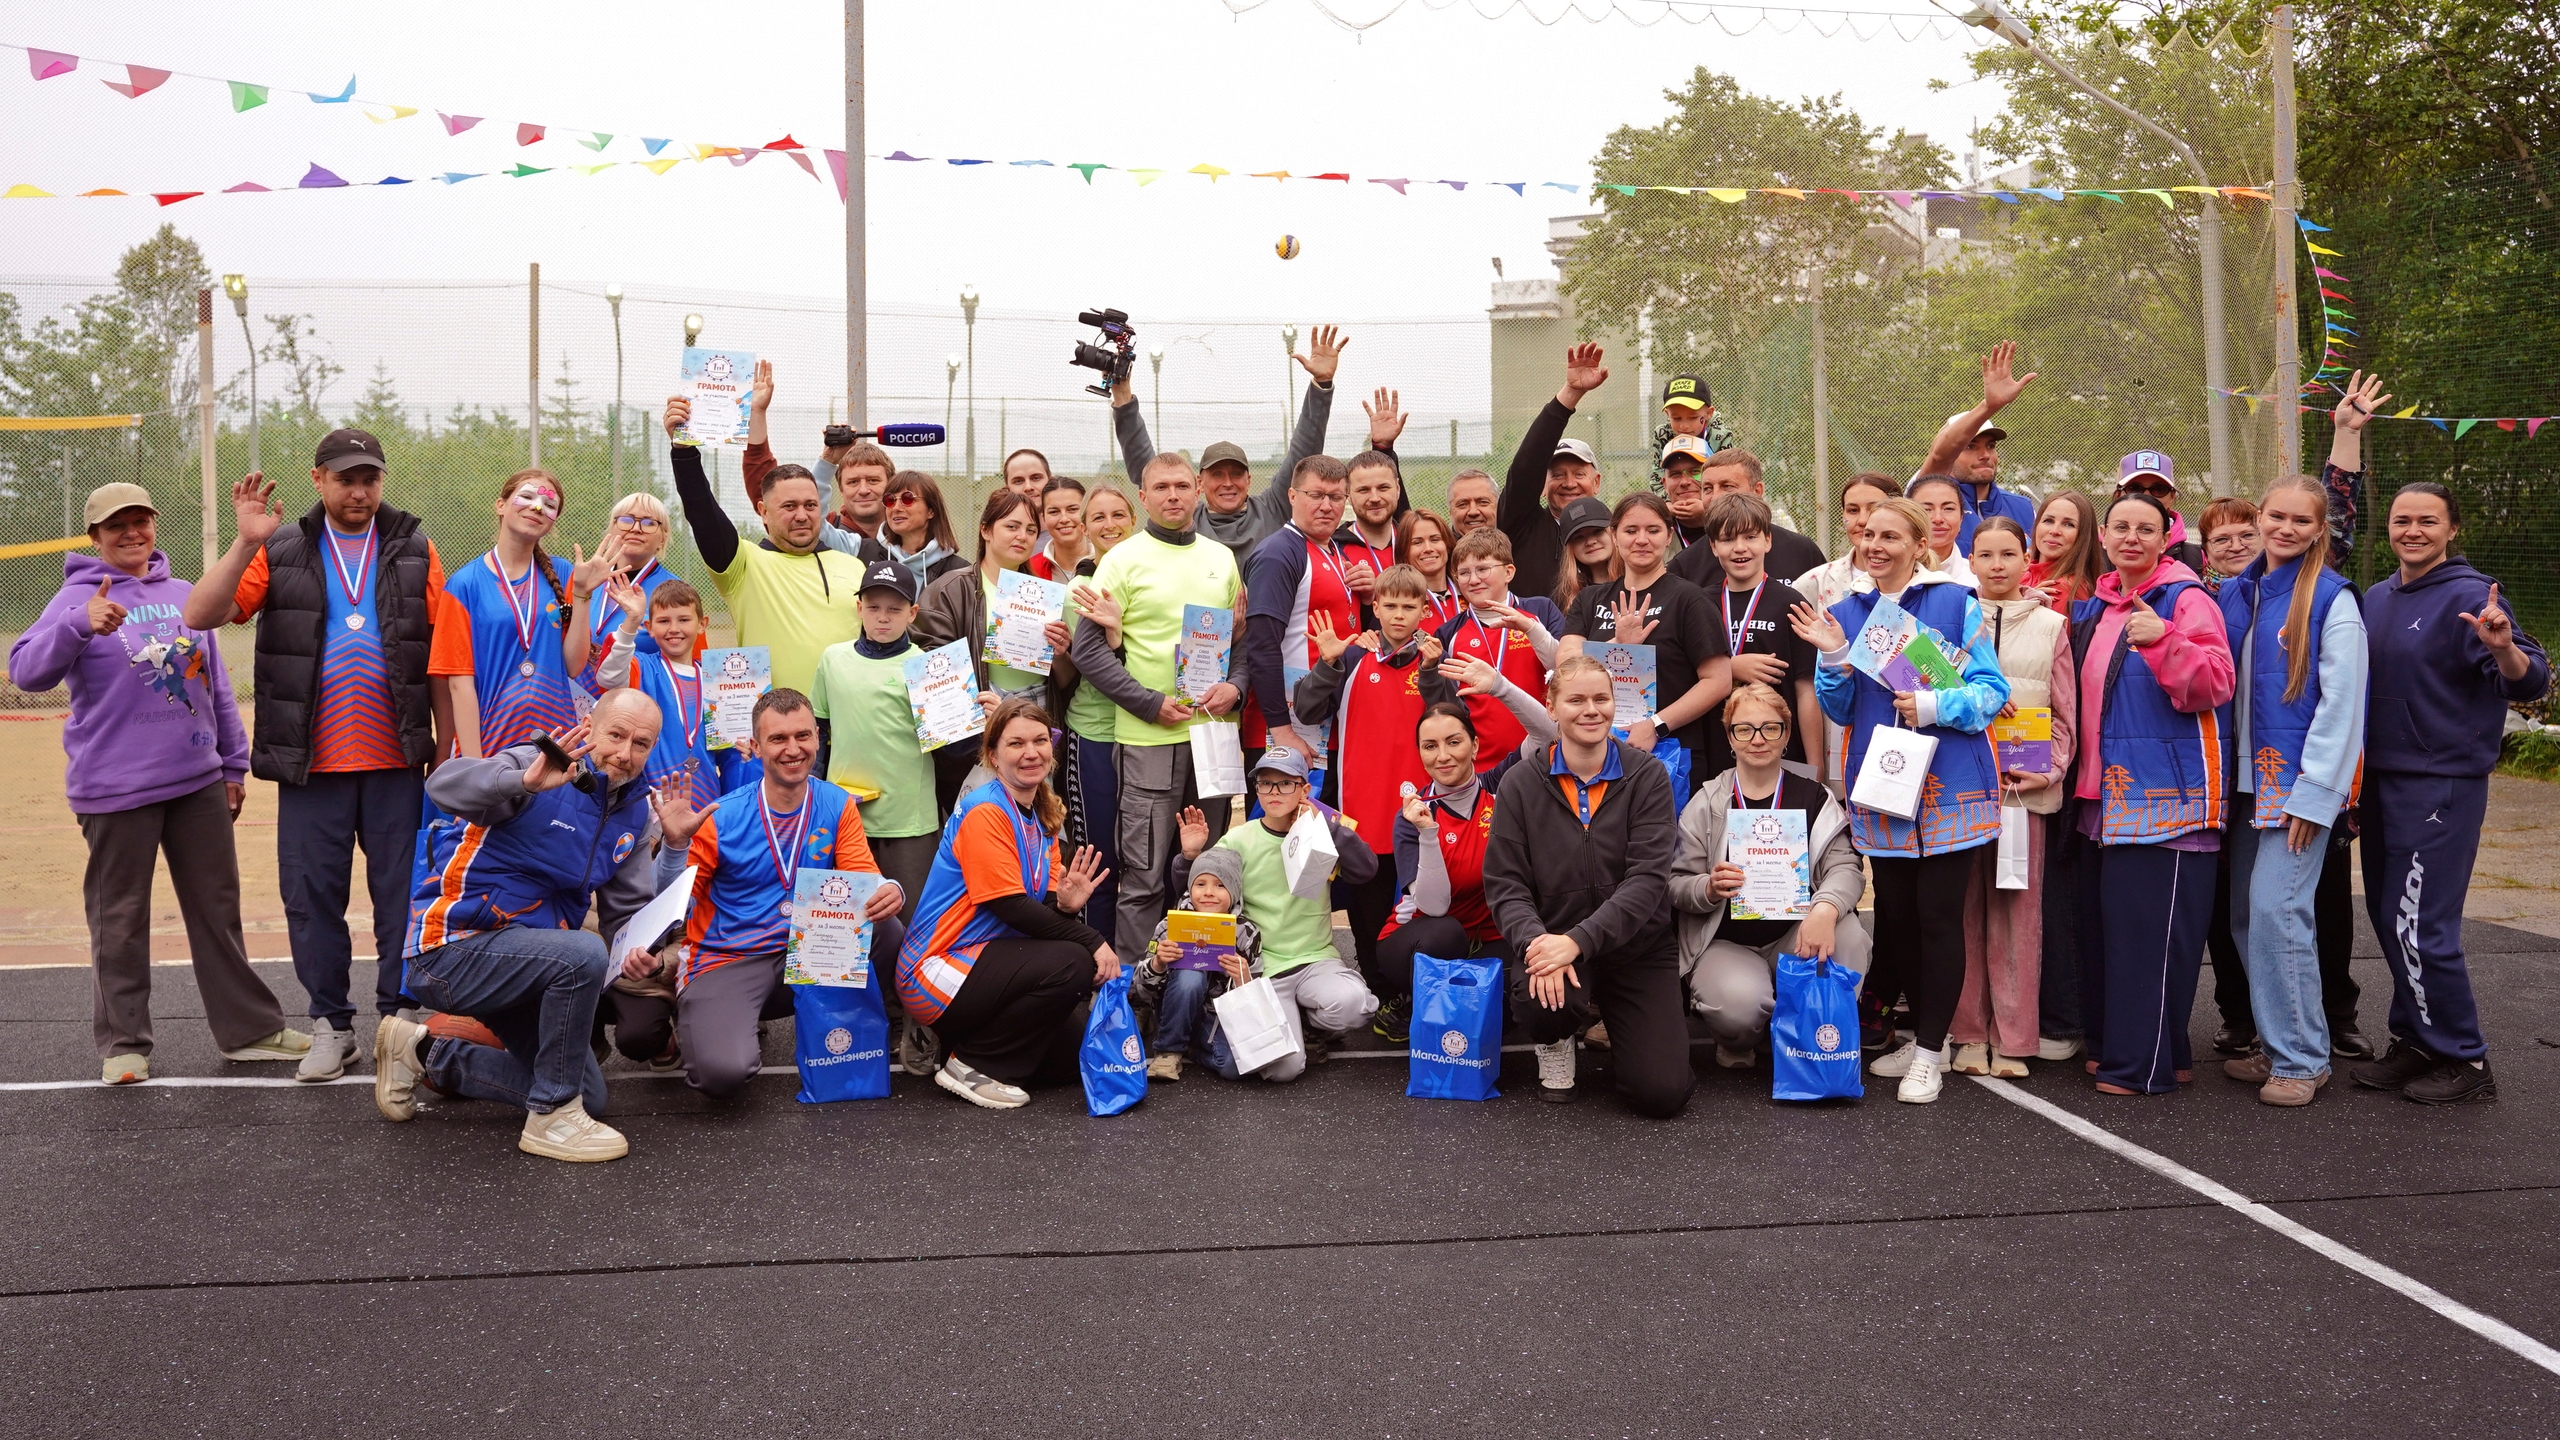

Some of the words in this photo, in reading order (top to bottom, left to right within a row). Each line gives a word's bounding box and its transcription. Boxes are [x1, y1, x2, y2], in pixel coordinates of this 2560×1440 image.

[697, 383, 736, 392] ГРАМОТА
[889, 432, 936, 444] РОССИЯ
[874, 574, 897, 582] adidas
[125, 603, 182, 626] NINJA
[1010, 602, 1046, 617] ГРАМОТА
[1192, 631, 1219, 641] ГРАМОТА
[1886, 628, 1909, 666] РАМОТА
[719, 681, 756, 691] ГРАМОТА
[924, 675, 960, 693] ГРАМОТА
[132, 708, 187, 725] NARUTO
[2006, 729, 2027, 737] THANK
[2008, 744, 2025, 756] You
[1747, 848, 1790, 856] ГРАМОТА
[811, 910, 855, 920] ГРАМОТА
[1191, 932, 1211, 940] THANK
[1193, 946, 1209, 955] You
[1411, 1048, 1491, 1069] Магаданэнерго
